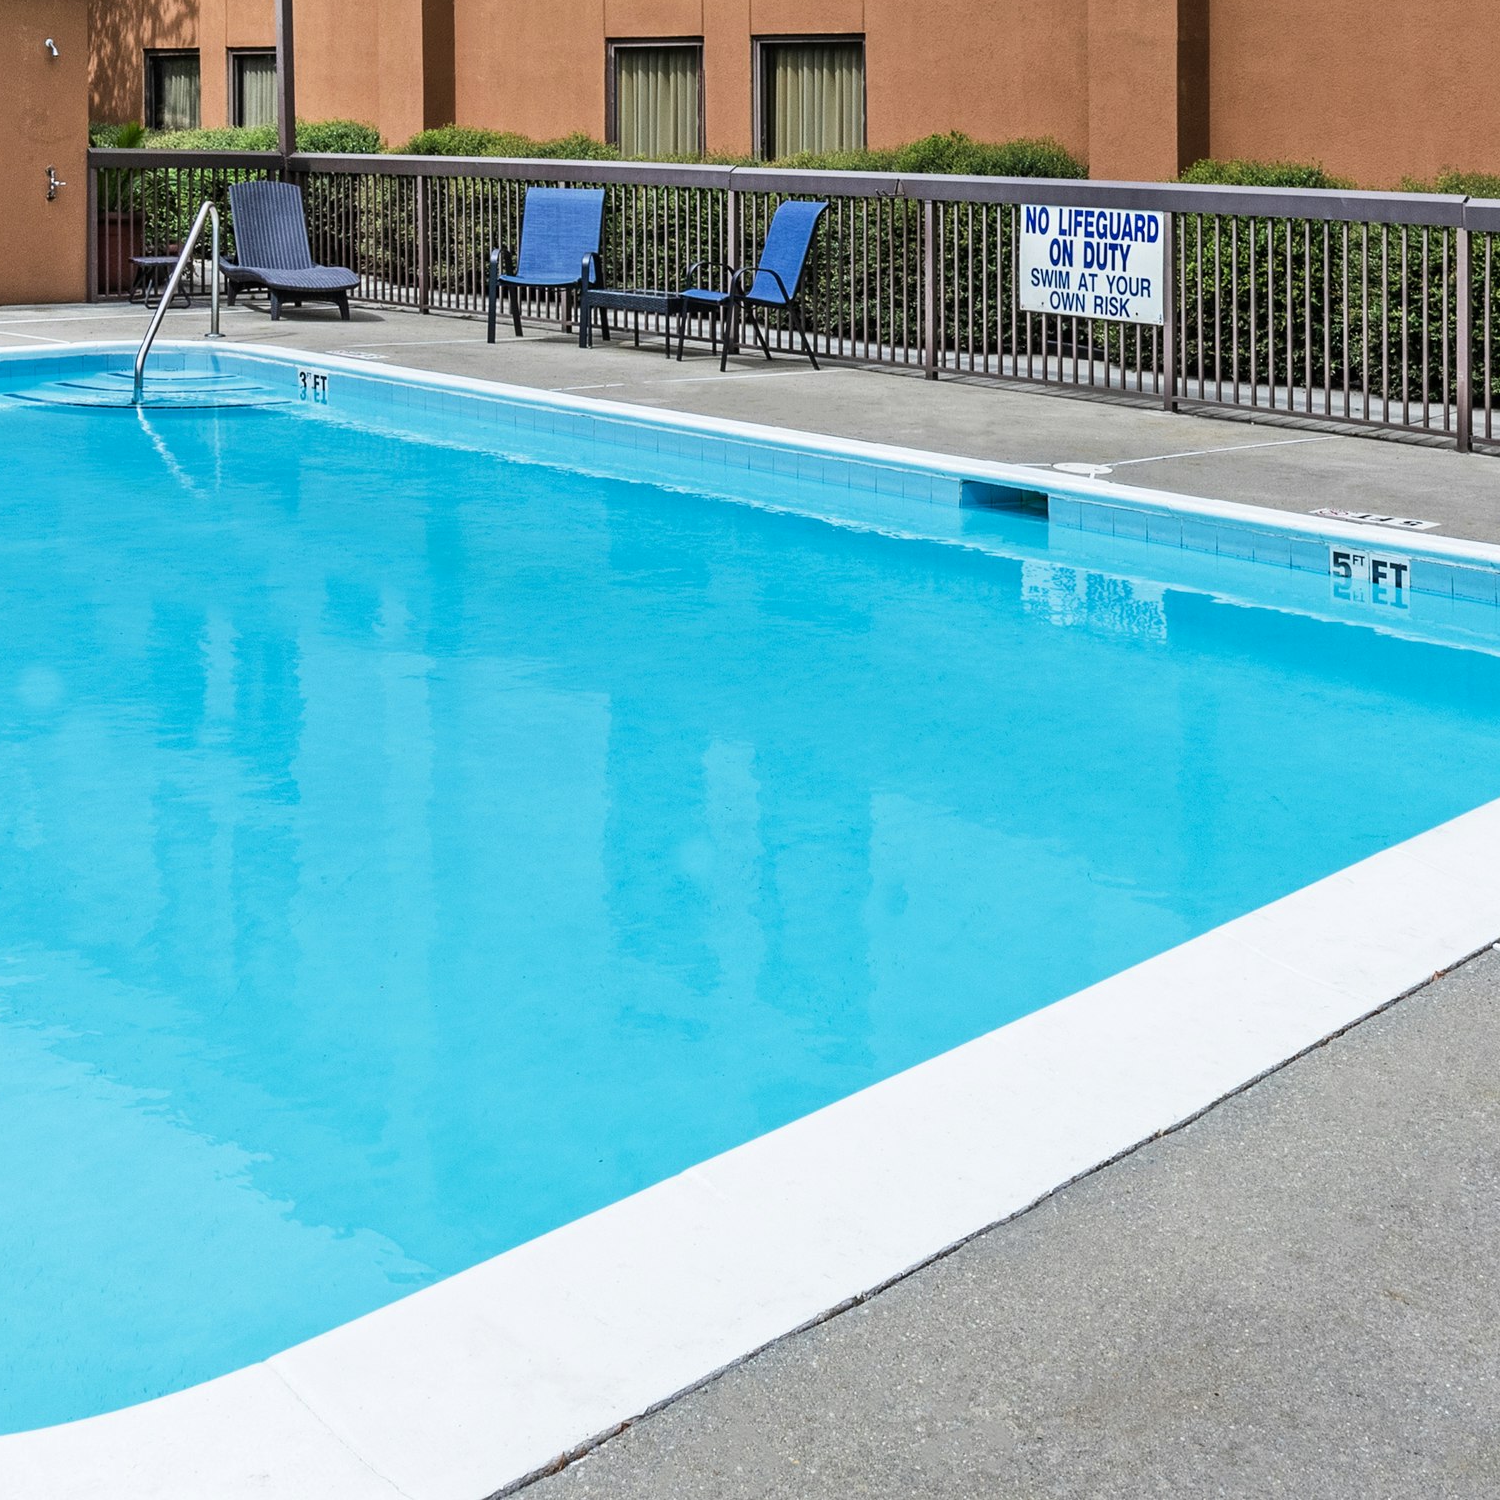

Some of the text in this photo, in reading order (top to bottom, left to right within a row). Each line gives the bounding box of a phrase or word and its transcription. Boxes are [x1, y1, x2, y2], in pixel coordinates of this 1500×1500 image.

[1025, 206, 1159, 243] NO LIFEGUARD
[1049, 238, 1132, 272] ON DUTY
[1031, 268, 1151, 298] SWIM AT YOUR
[1050, 290, 1130, 318] OWN RISK
[299, 371, 307, 388] 3
[313, 375, 328, 391] FT
[1333, 551, 1408, 588] 5 FT FT
